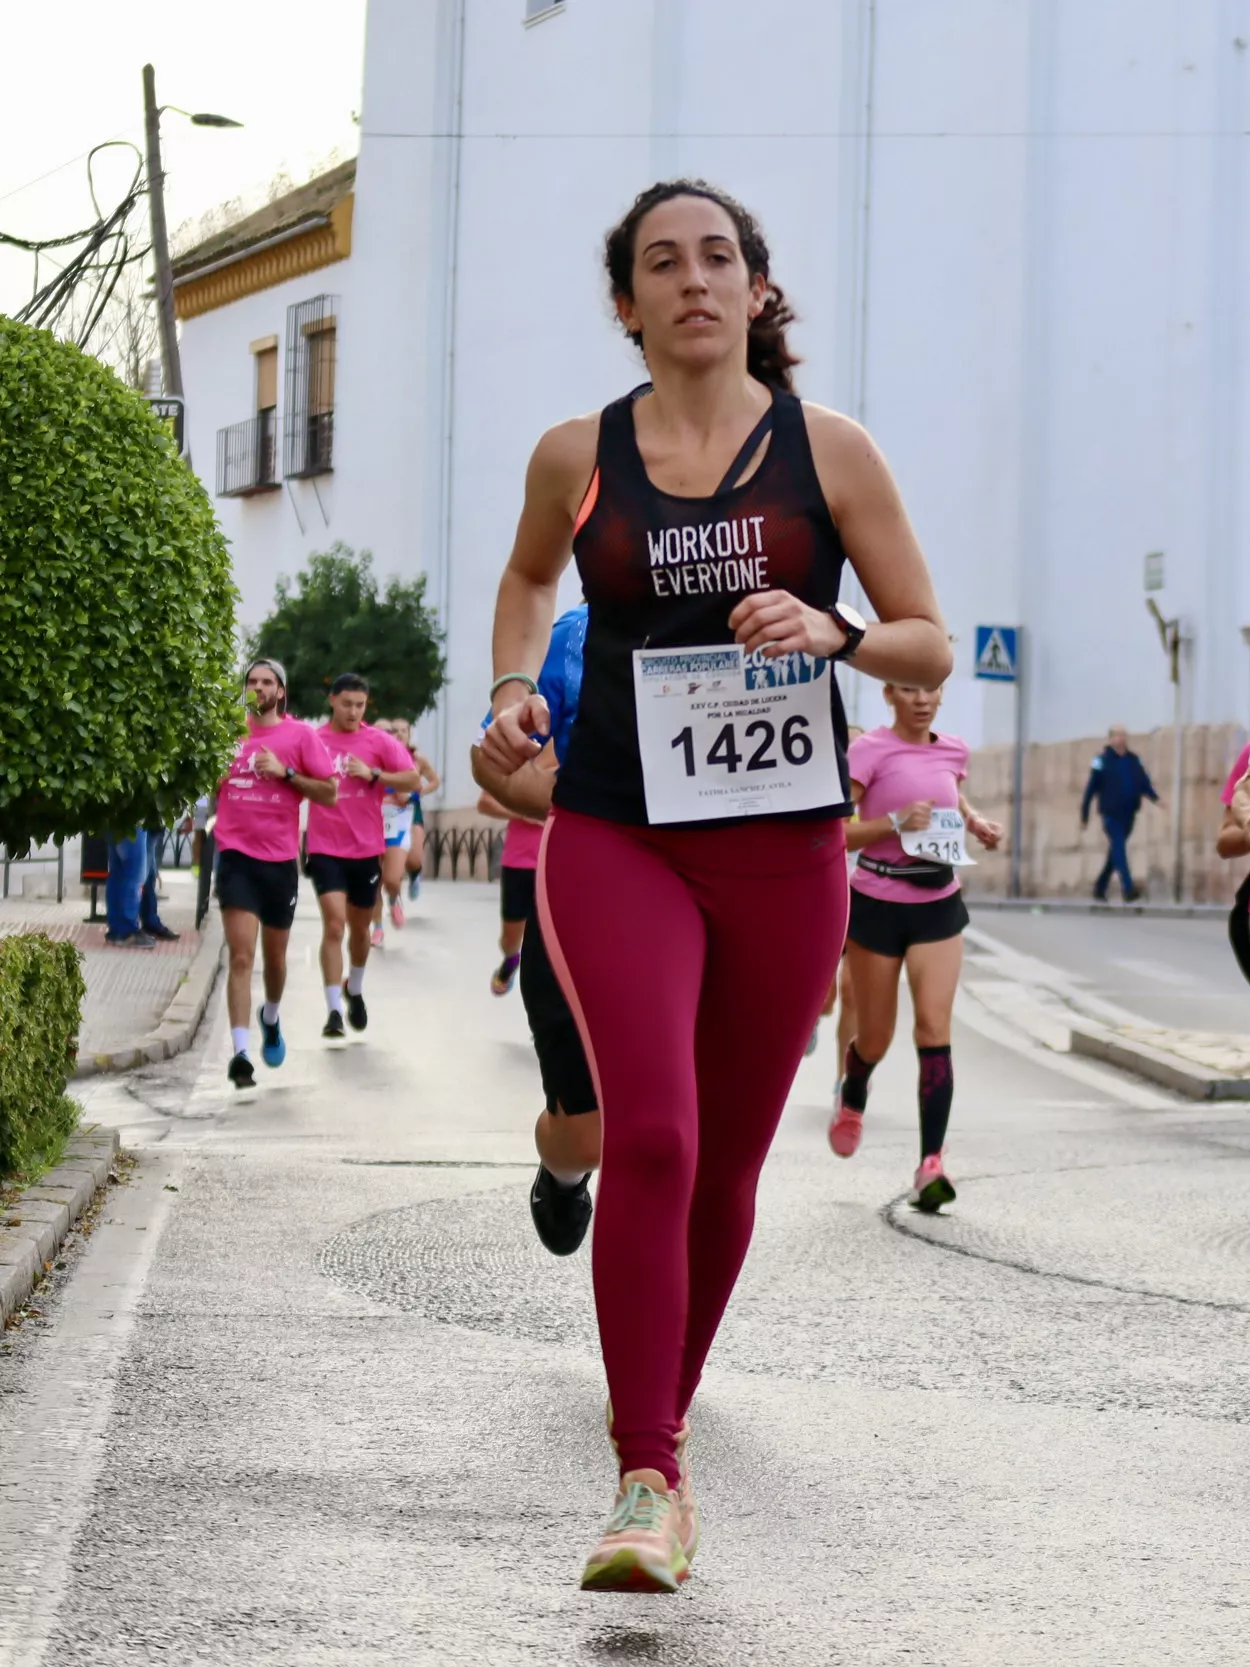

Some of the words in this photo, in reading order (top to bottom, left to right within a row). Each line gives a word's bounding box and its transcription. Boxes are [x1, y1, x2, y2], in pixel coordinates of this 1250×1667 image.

[647, 516, 764, 566] WORKOUT
[651, 557, 770, 597] EVERYONE
[707, 711, 722, 719] POR
[671, 714, 813, 777] 1426
